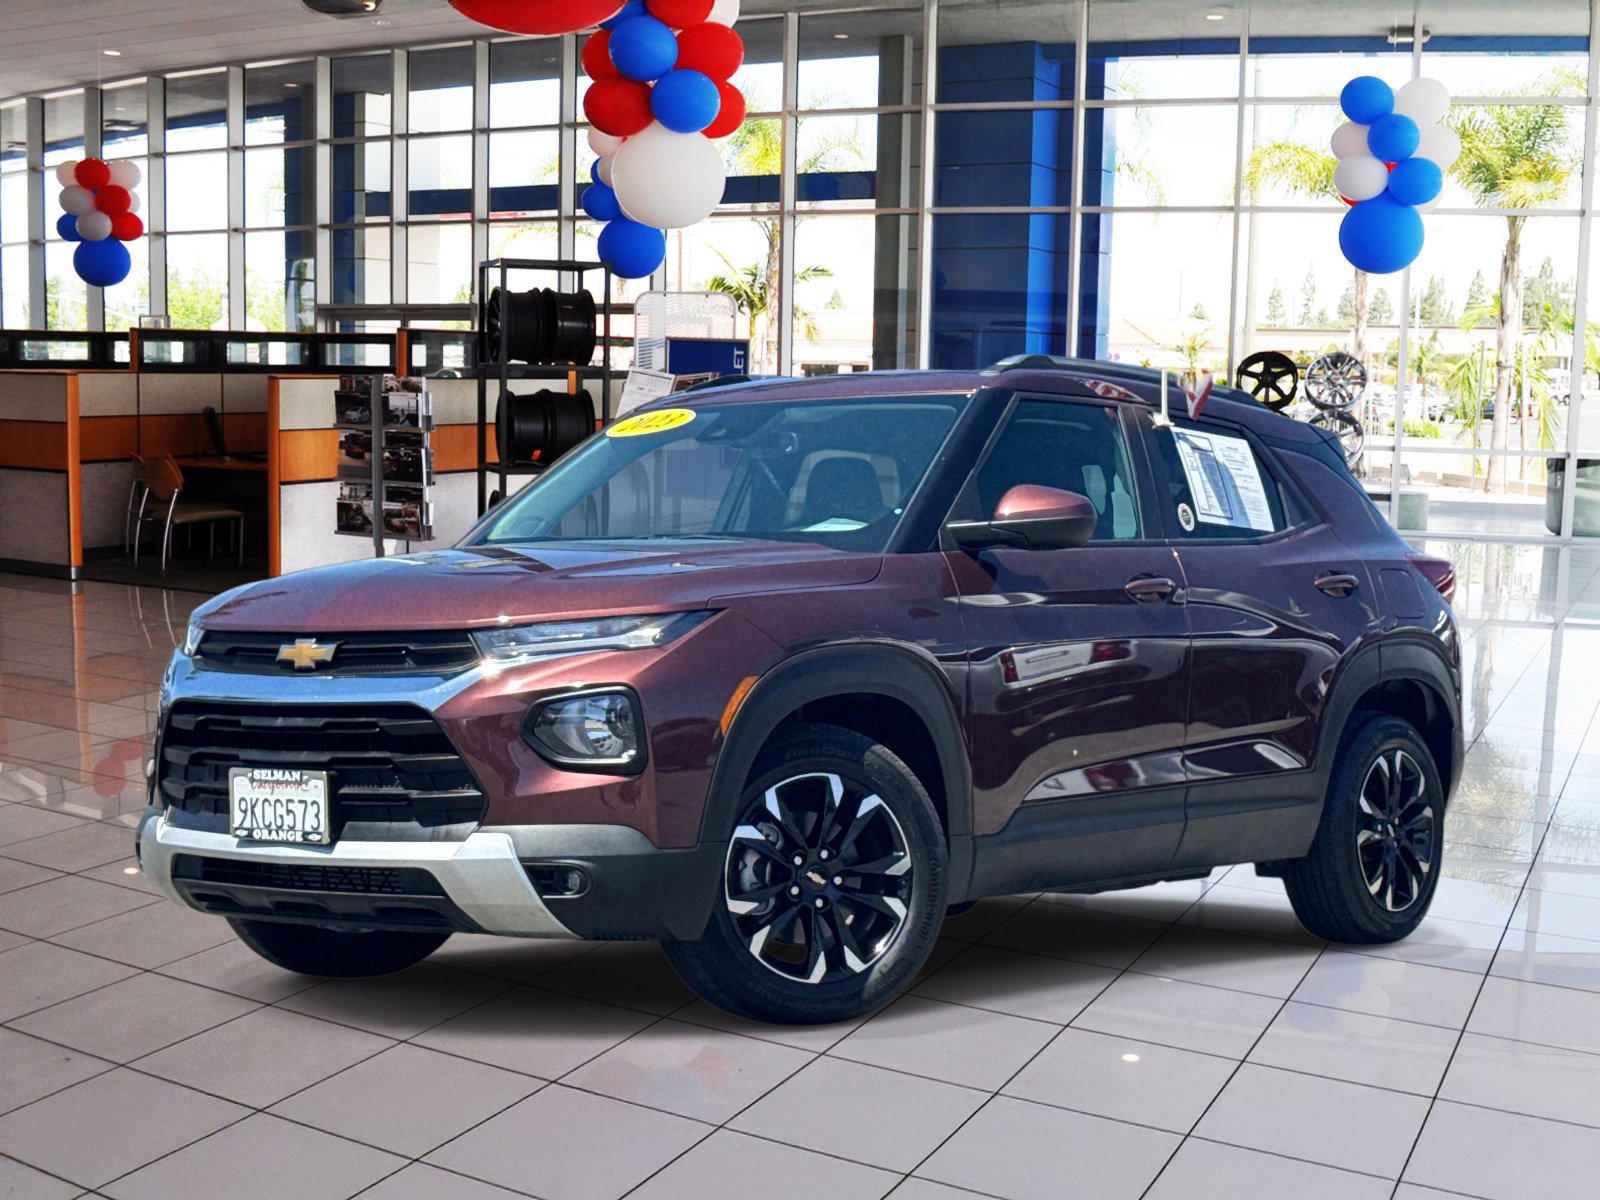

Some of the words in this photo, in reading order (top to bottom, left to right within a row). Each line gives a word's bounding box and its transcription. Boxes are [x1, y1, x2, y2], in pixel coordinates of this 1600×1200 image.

[253, 769, 301, 782] SELMAN
[238, 797, 320, 830] 9KCG573
[252, 828, 304, 841] ORANGE
